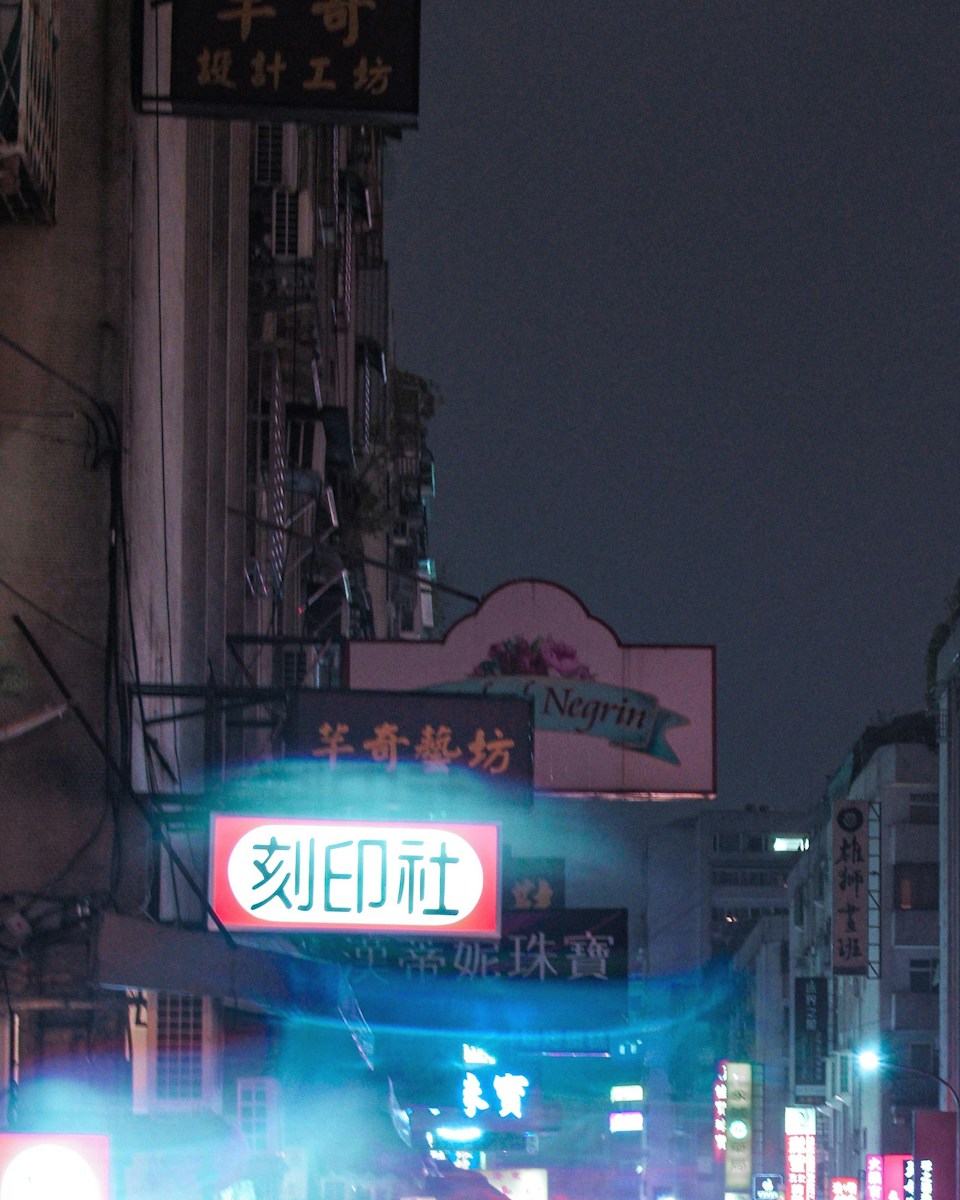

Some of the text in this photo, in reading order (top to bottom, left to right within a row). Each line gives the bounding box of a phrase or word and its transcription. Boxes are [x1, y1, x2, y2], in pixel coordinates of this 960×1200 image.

[197, 47, 392, 95] 設計工坊
[542, 686, 651, 734] Negrin
[250, 836, 460, 917] 刻印社
